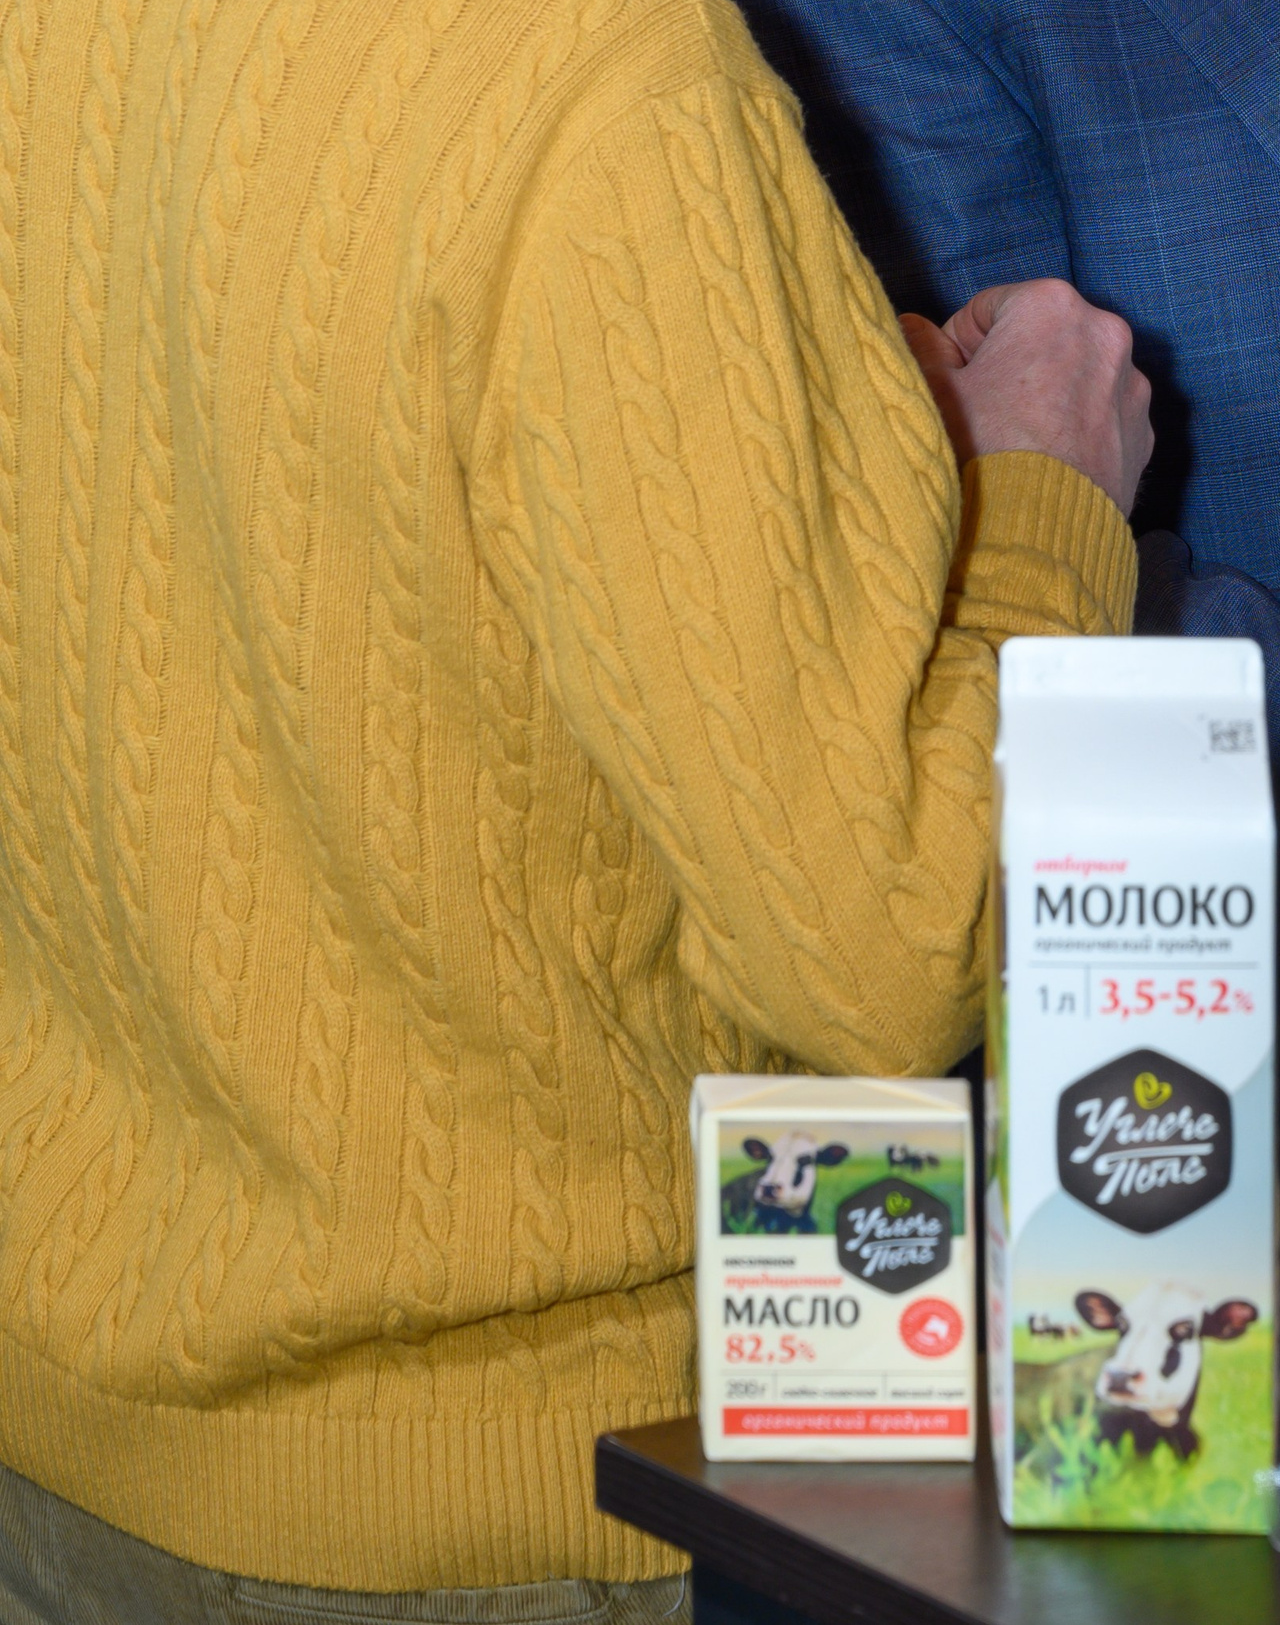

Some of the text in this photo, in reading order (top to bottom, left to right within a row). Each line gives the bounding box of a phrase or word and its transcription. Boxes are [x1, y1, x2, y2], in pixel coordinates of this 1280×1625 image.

[1033, 882, 1256, 928] МОЛОКО
[1037, 984, 1050, 1014] 1
[1055, 989, 1076, 1015] л
[1069, 1096, 1220, 1165] Углече
[1093, 1144, 1214, 1206] Поле
[723, 1295, 861, 1328] МАСЛО
[741, 1412, 949, 1433] органический продукт
